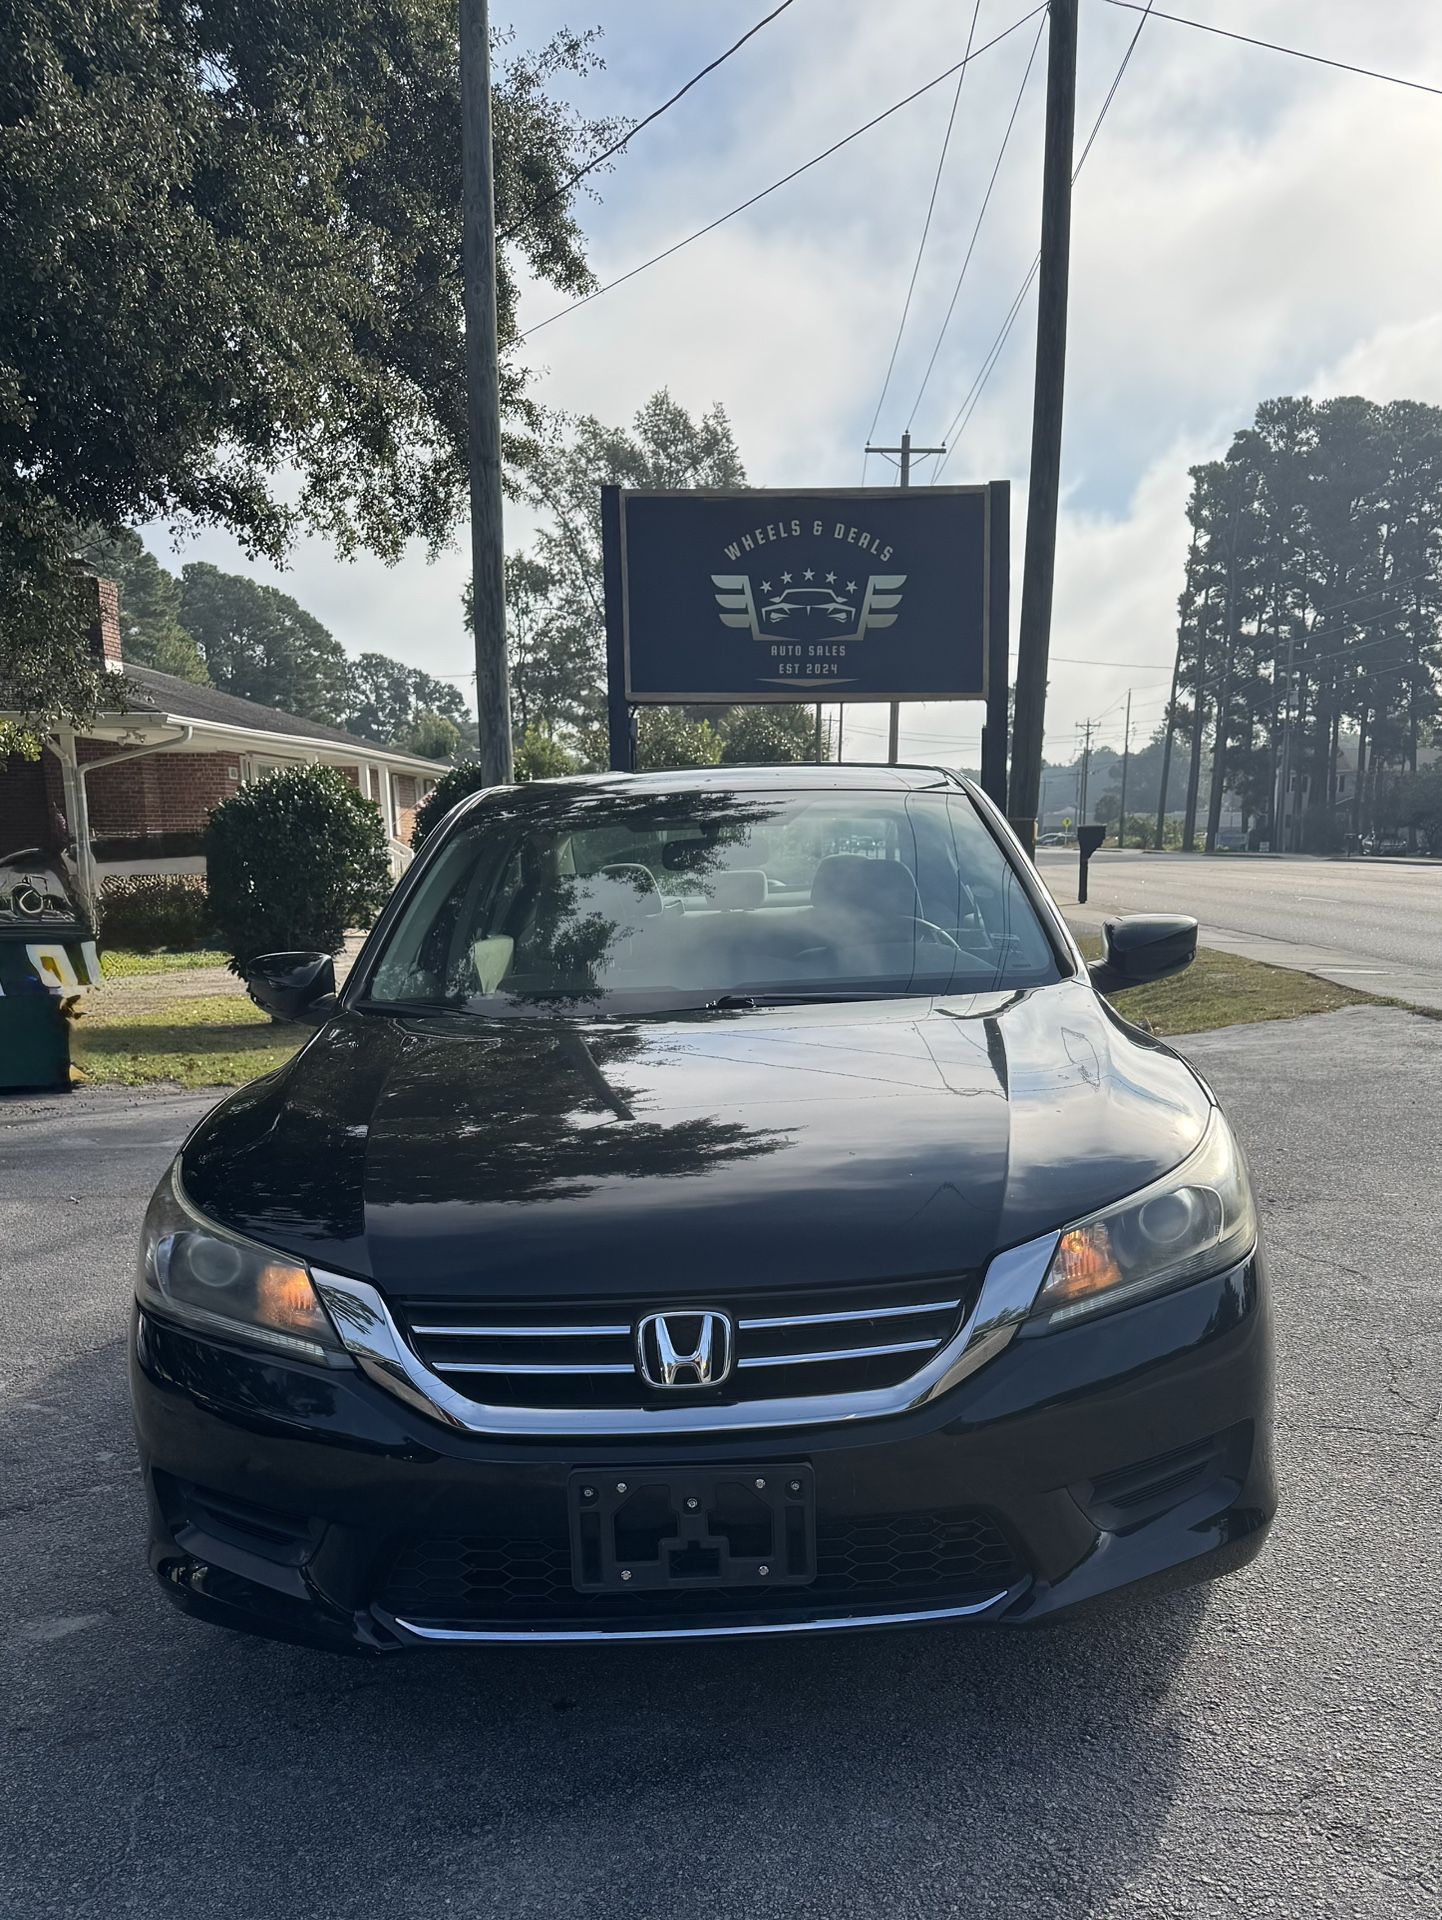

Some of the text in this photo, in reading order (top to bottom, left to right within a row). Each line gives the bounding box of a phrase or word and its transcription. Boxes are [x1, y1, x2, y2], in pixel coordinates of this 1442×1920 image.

[724, 520, 894, 562] WHEELS & DEALS
[770, 645, 846, 656] AUTO SALES
[778, 663, 838, 674] EST 2024
